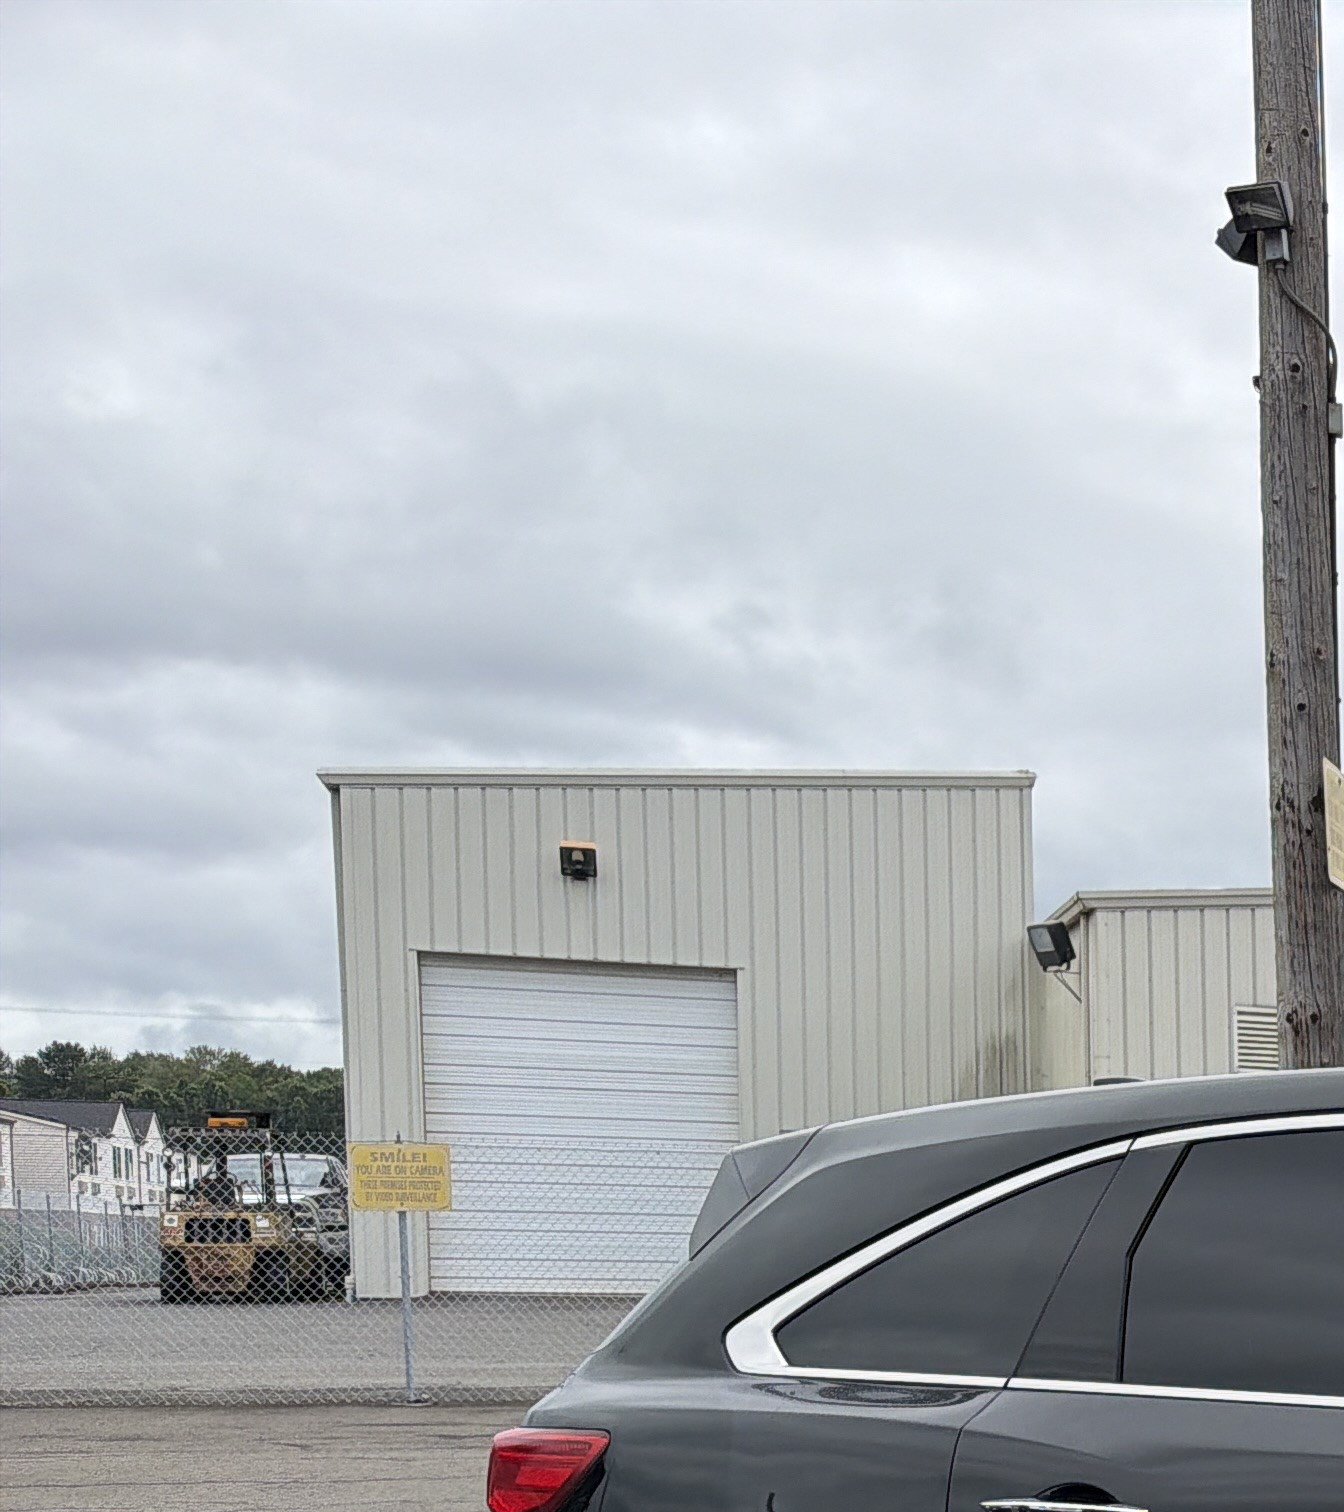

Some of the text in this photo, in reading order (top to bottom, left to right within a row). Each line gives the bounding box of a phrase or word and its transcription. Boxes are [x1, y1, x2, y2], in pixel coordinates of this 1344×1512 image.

[370, 1151, 427, 1162] SMILE!
[356, 1164, 444, 1176] YOU ARE ON CAMERA
